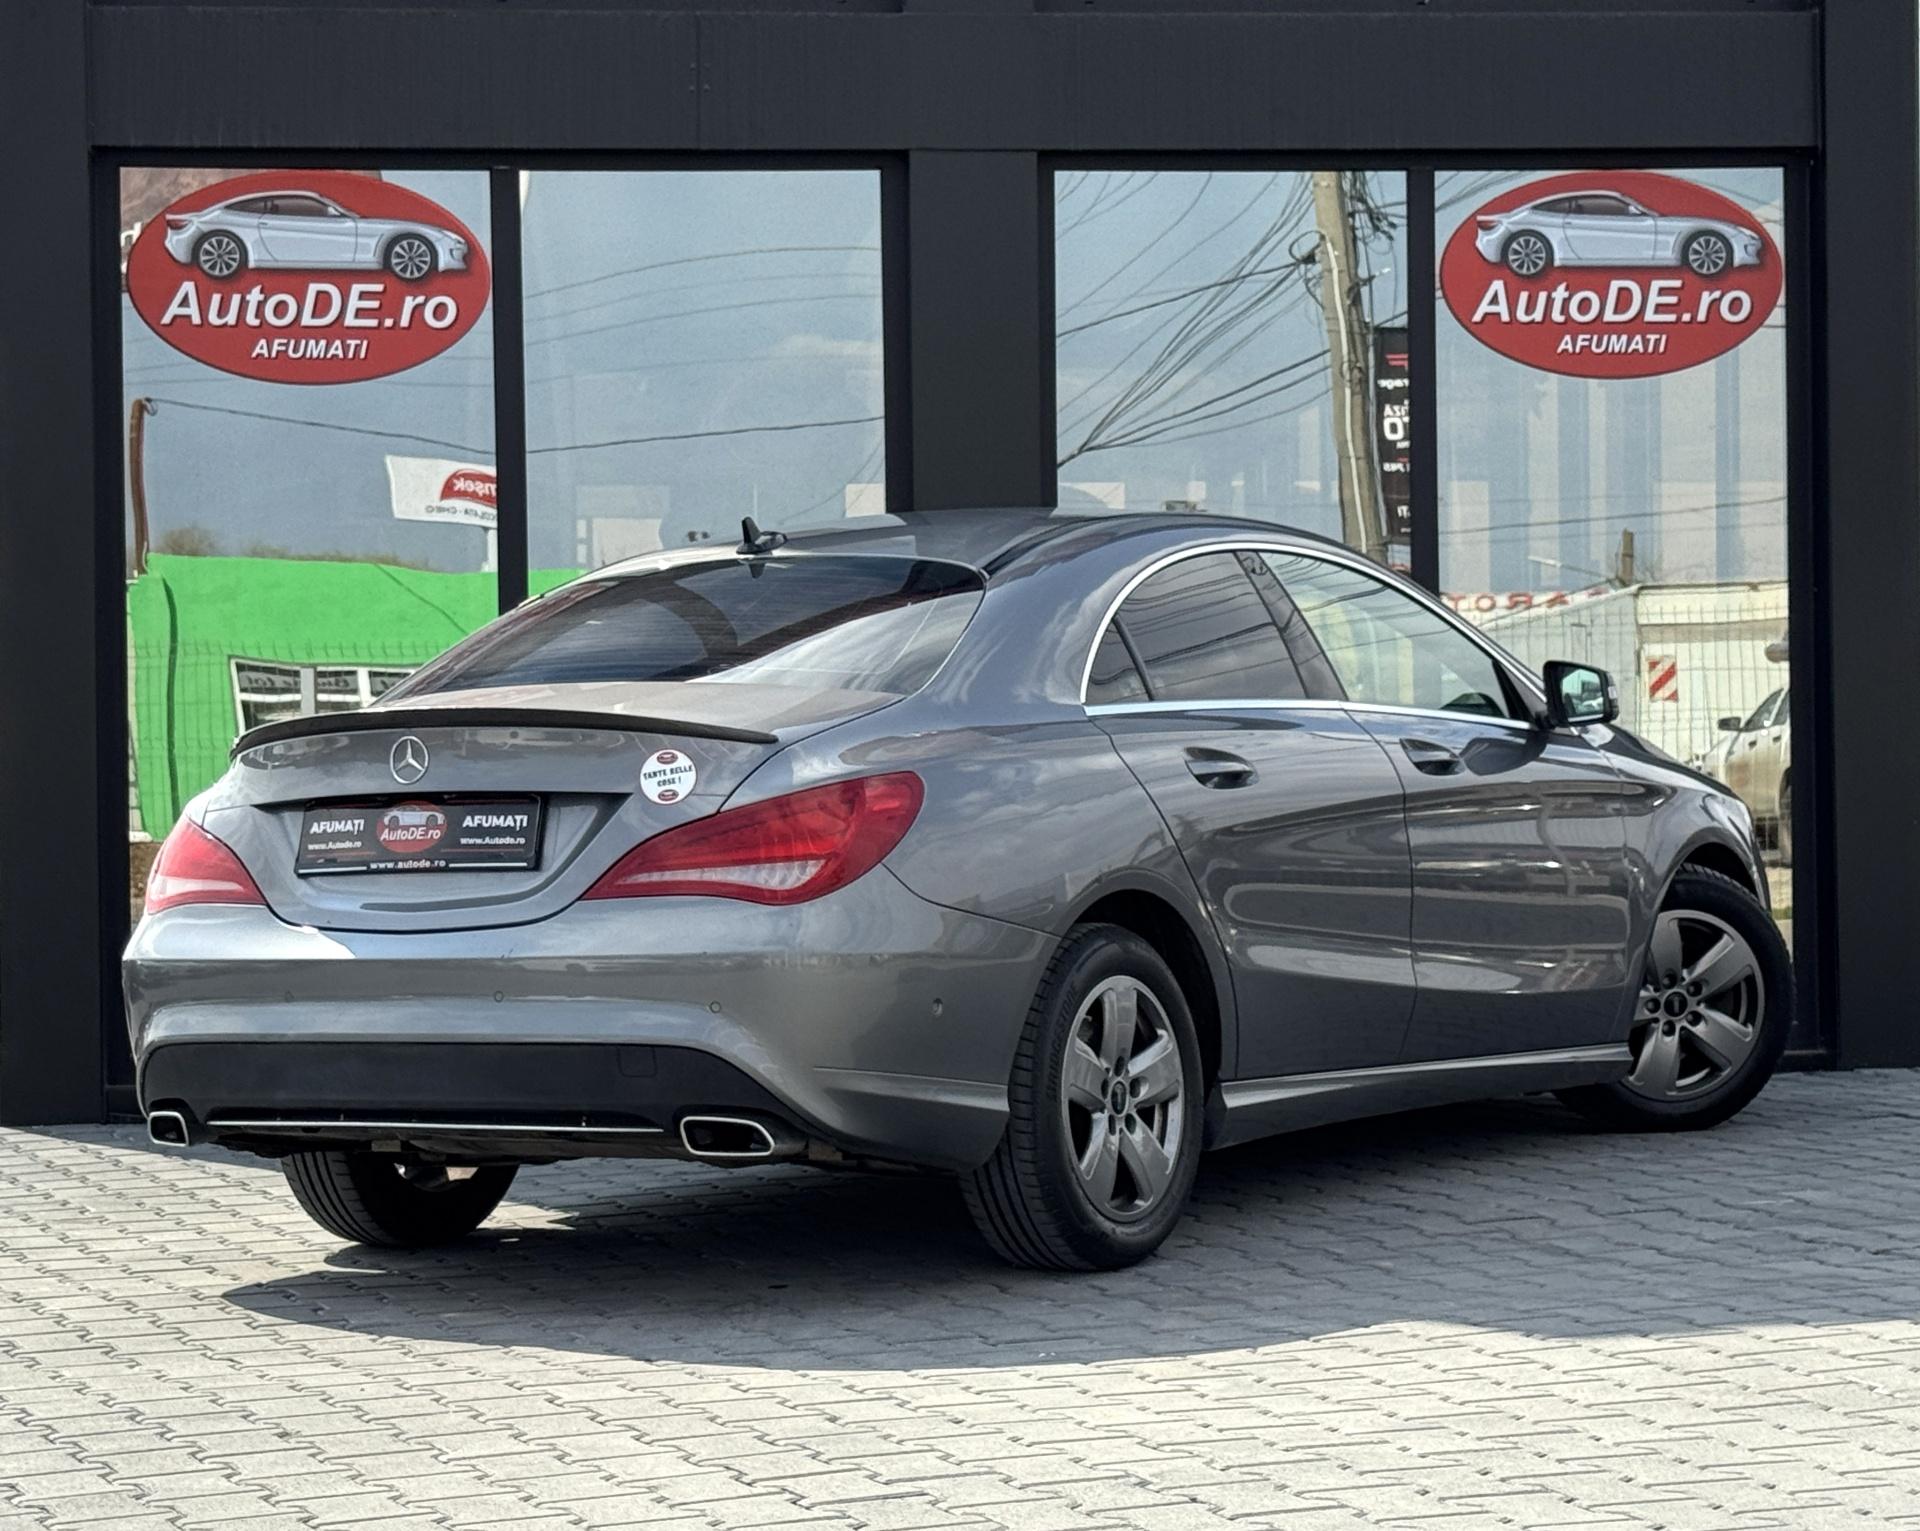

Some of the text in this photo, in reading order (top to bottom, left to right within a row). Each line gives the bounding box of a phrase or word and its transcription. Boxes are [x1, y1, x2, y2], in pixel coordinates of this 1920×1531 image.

[160, 281, 457, 329] AutoDE.ro
[1472, 279, 1752, 323] AutoDE.ro
[251, 338, 368, 359] AFUMATI
[1557, 334, 1667, 354] AFUMATI
[380, 827, 441, 842] AutoDE.ro
